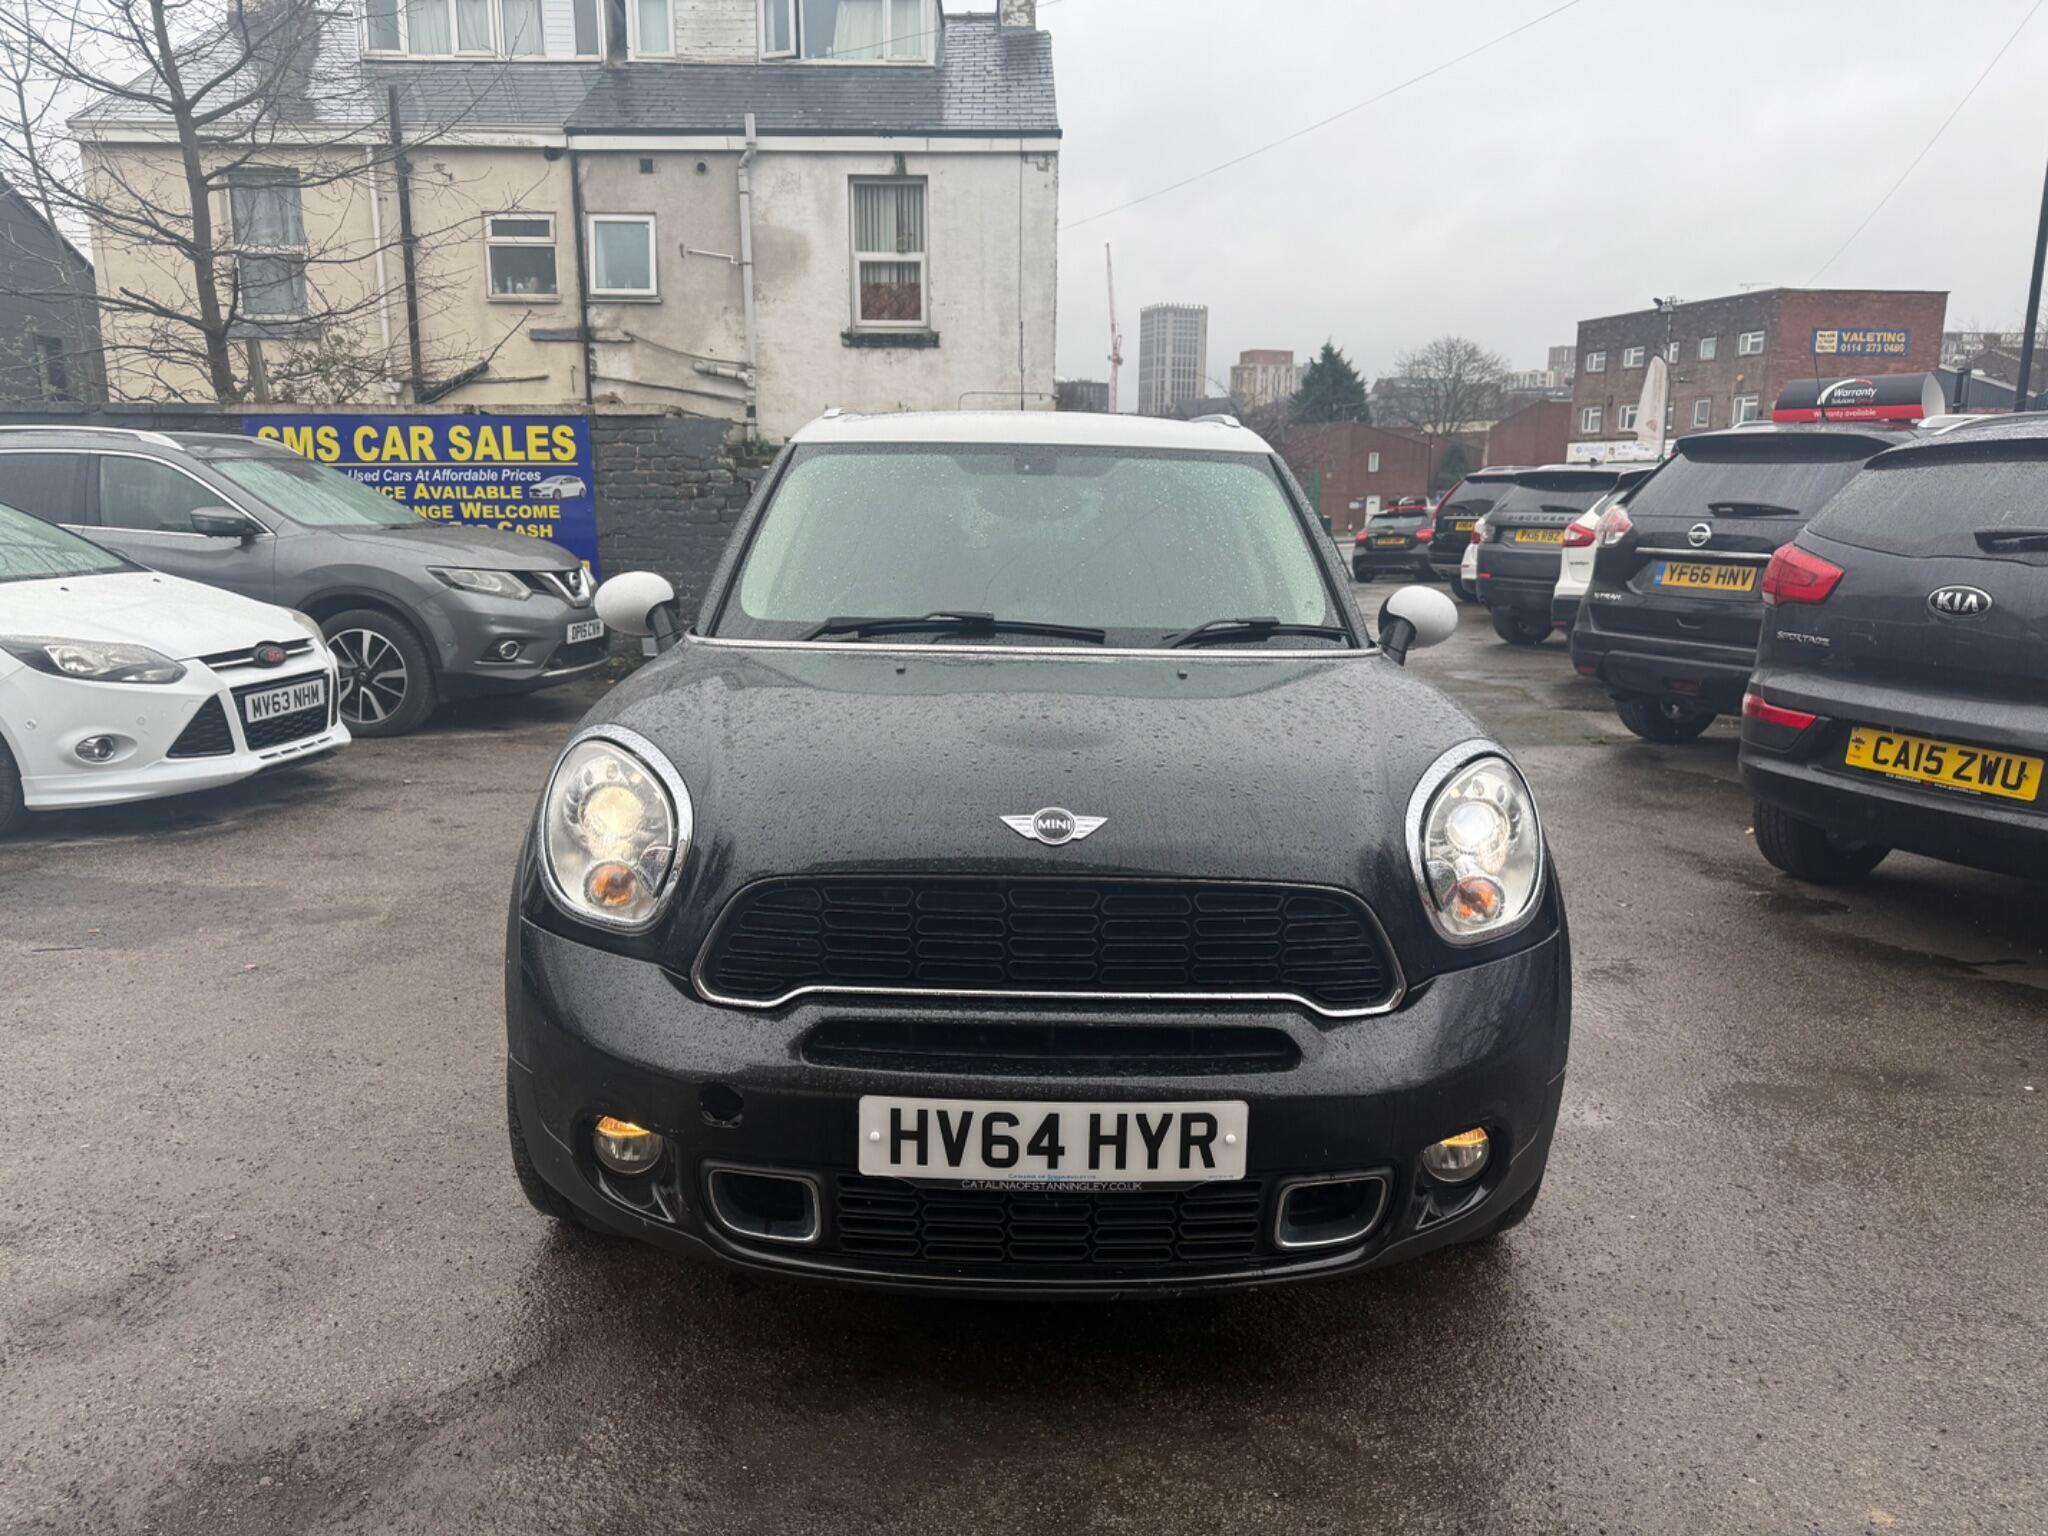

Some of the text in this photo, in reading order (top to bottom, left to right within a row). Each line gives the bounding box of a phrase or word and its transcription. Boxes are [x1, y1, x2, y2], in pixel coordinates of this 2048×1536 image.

[1842, 332, 1905, 342] VALETING
[1841, 343, 1861, 352] 0114
[1866, 343, 1882, 352] 273
[1834, 387, 1877, 398] Warranty
[354, 426, 438, 462] CAR
[448, 425, 577, 462] SALES
[383, 469, 412, 481] Cars
[415, 469, 430, 481] At
[432, 468, 498, 481] Affordable
[501, 469, 541, 481] Prices
[414, 482, 523, 499] AVAILABLE
[460, 502, 560, 519] WELCOME
[1668, 563, 1752, 587] YF66 HNV
[1936, 591, 1980, 612] KIA
[251, 684, 320, 719] MV63 NHM
[1872, 736, 2028, 791] CA15 ZWU
[1037, 819, 1071, 830] MINI
[889, 1107, 1218, 1170] HV64 HYR
